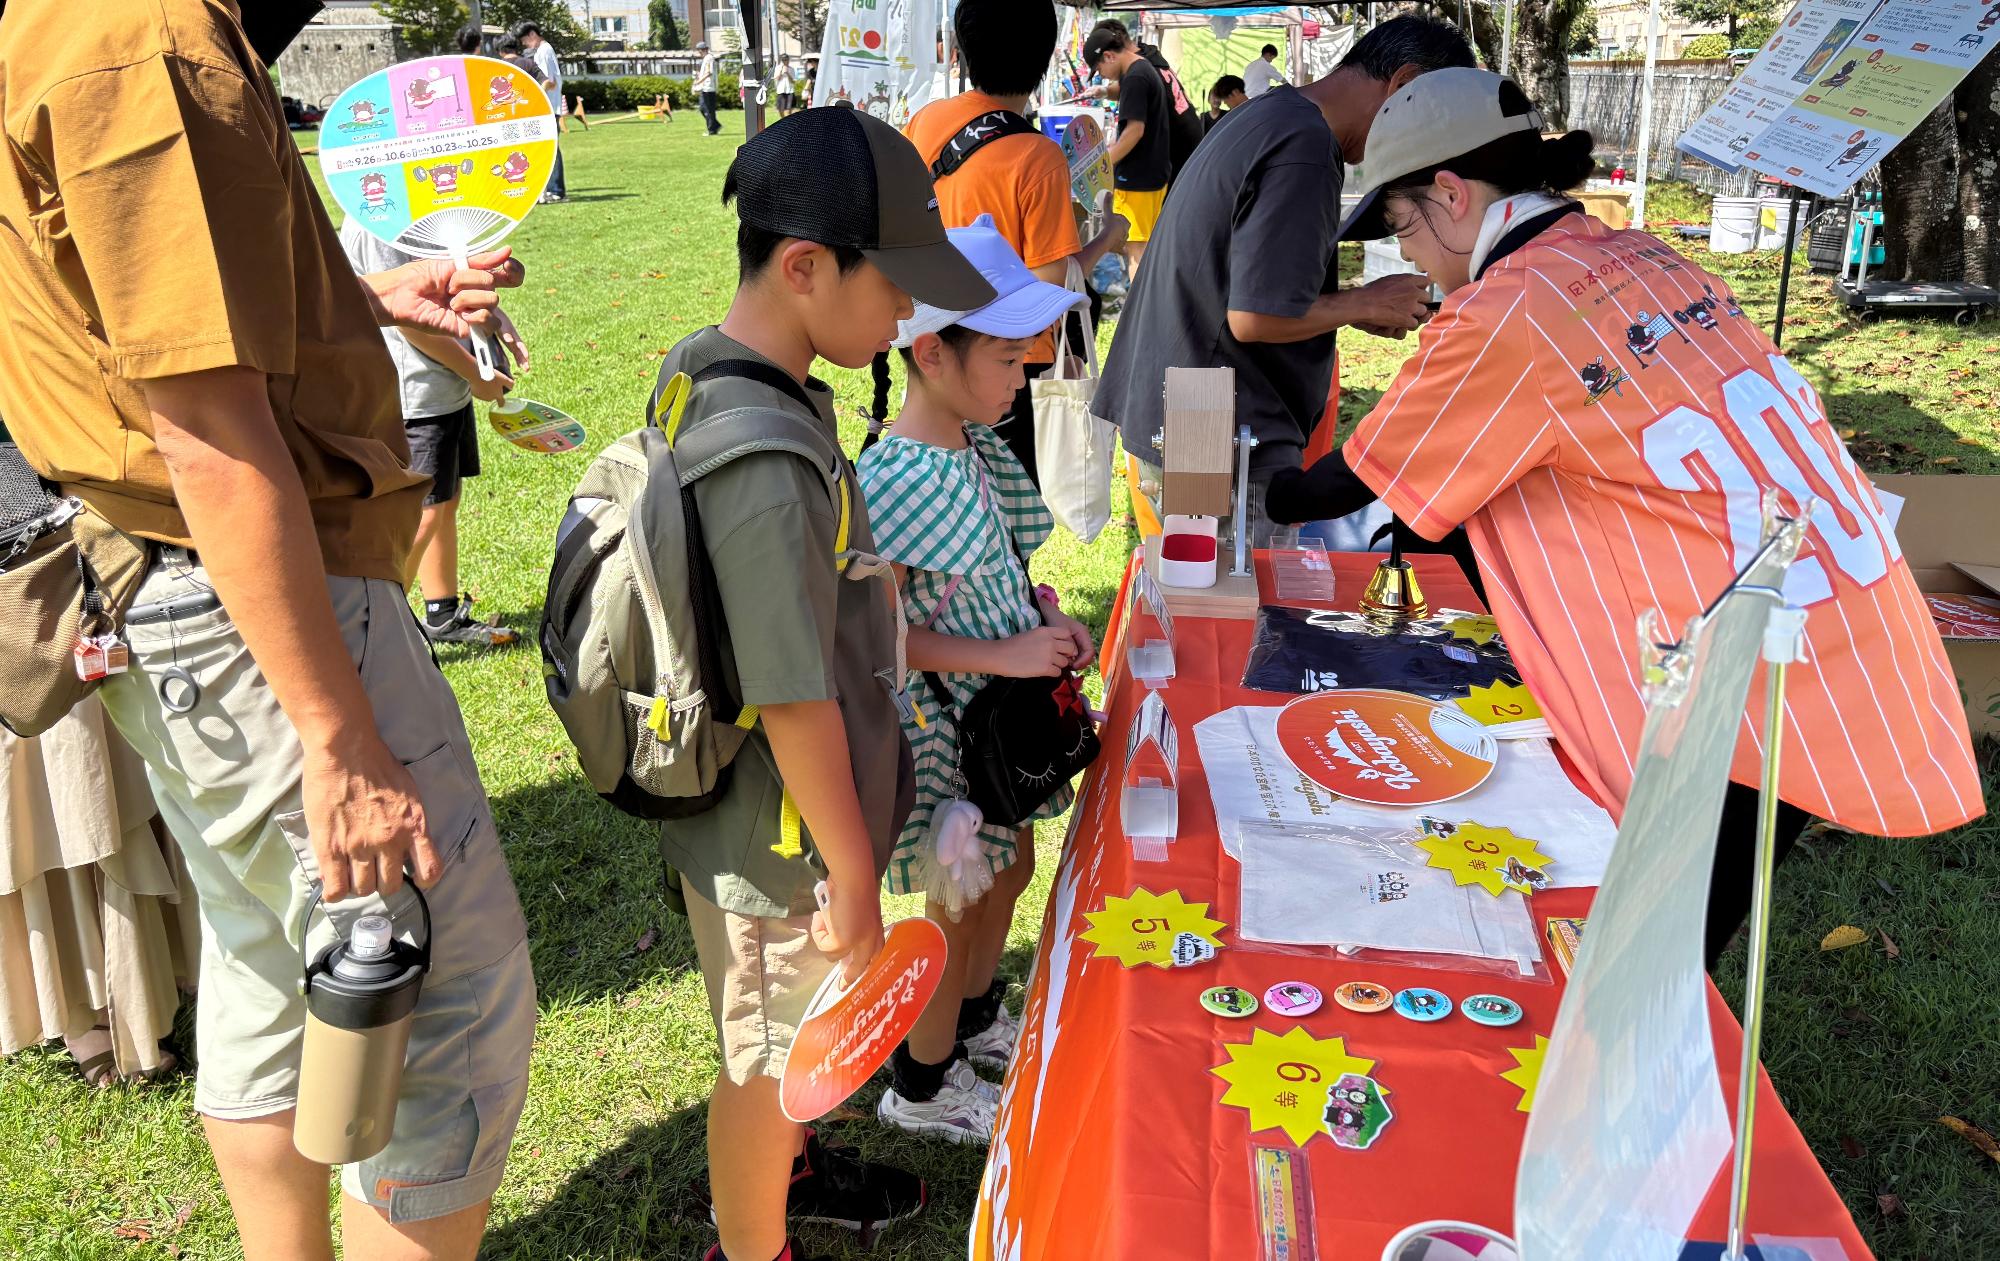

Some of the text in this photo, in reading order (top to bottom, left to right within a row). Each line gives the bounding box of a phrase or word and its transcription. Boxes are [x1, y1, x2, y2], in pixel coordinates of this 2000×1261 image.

[355, 156, 376, 166] 9.26
[385, 150, 406, 161] 10.6
[430, 142, 458, 154] 10.23
[467, 136, 494, 148] 10.25
[1491, 702, 1524, 725] 2
[1330, 708, 1421, 790] Kobayashi
[807, 956, 929, 1089] Kobayashi
